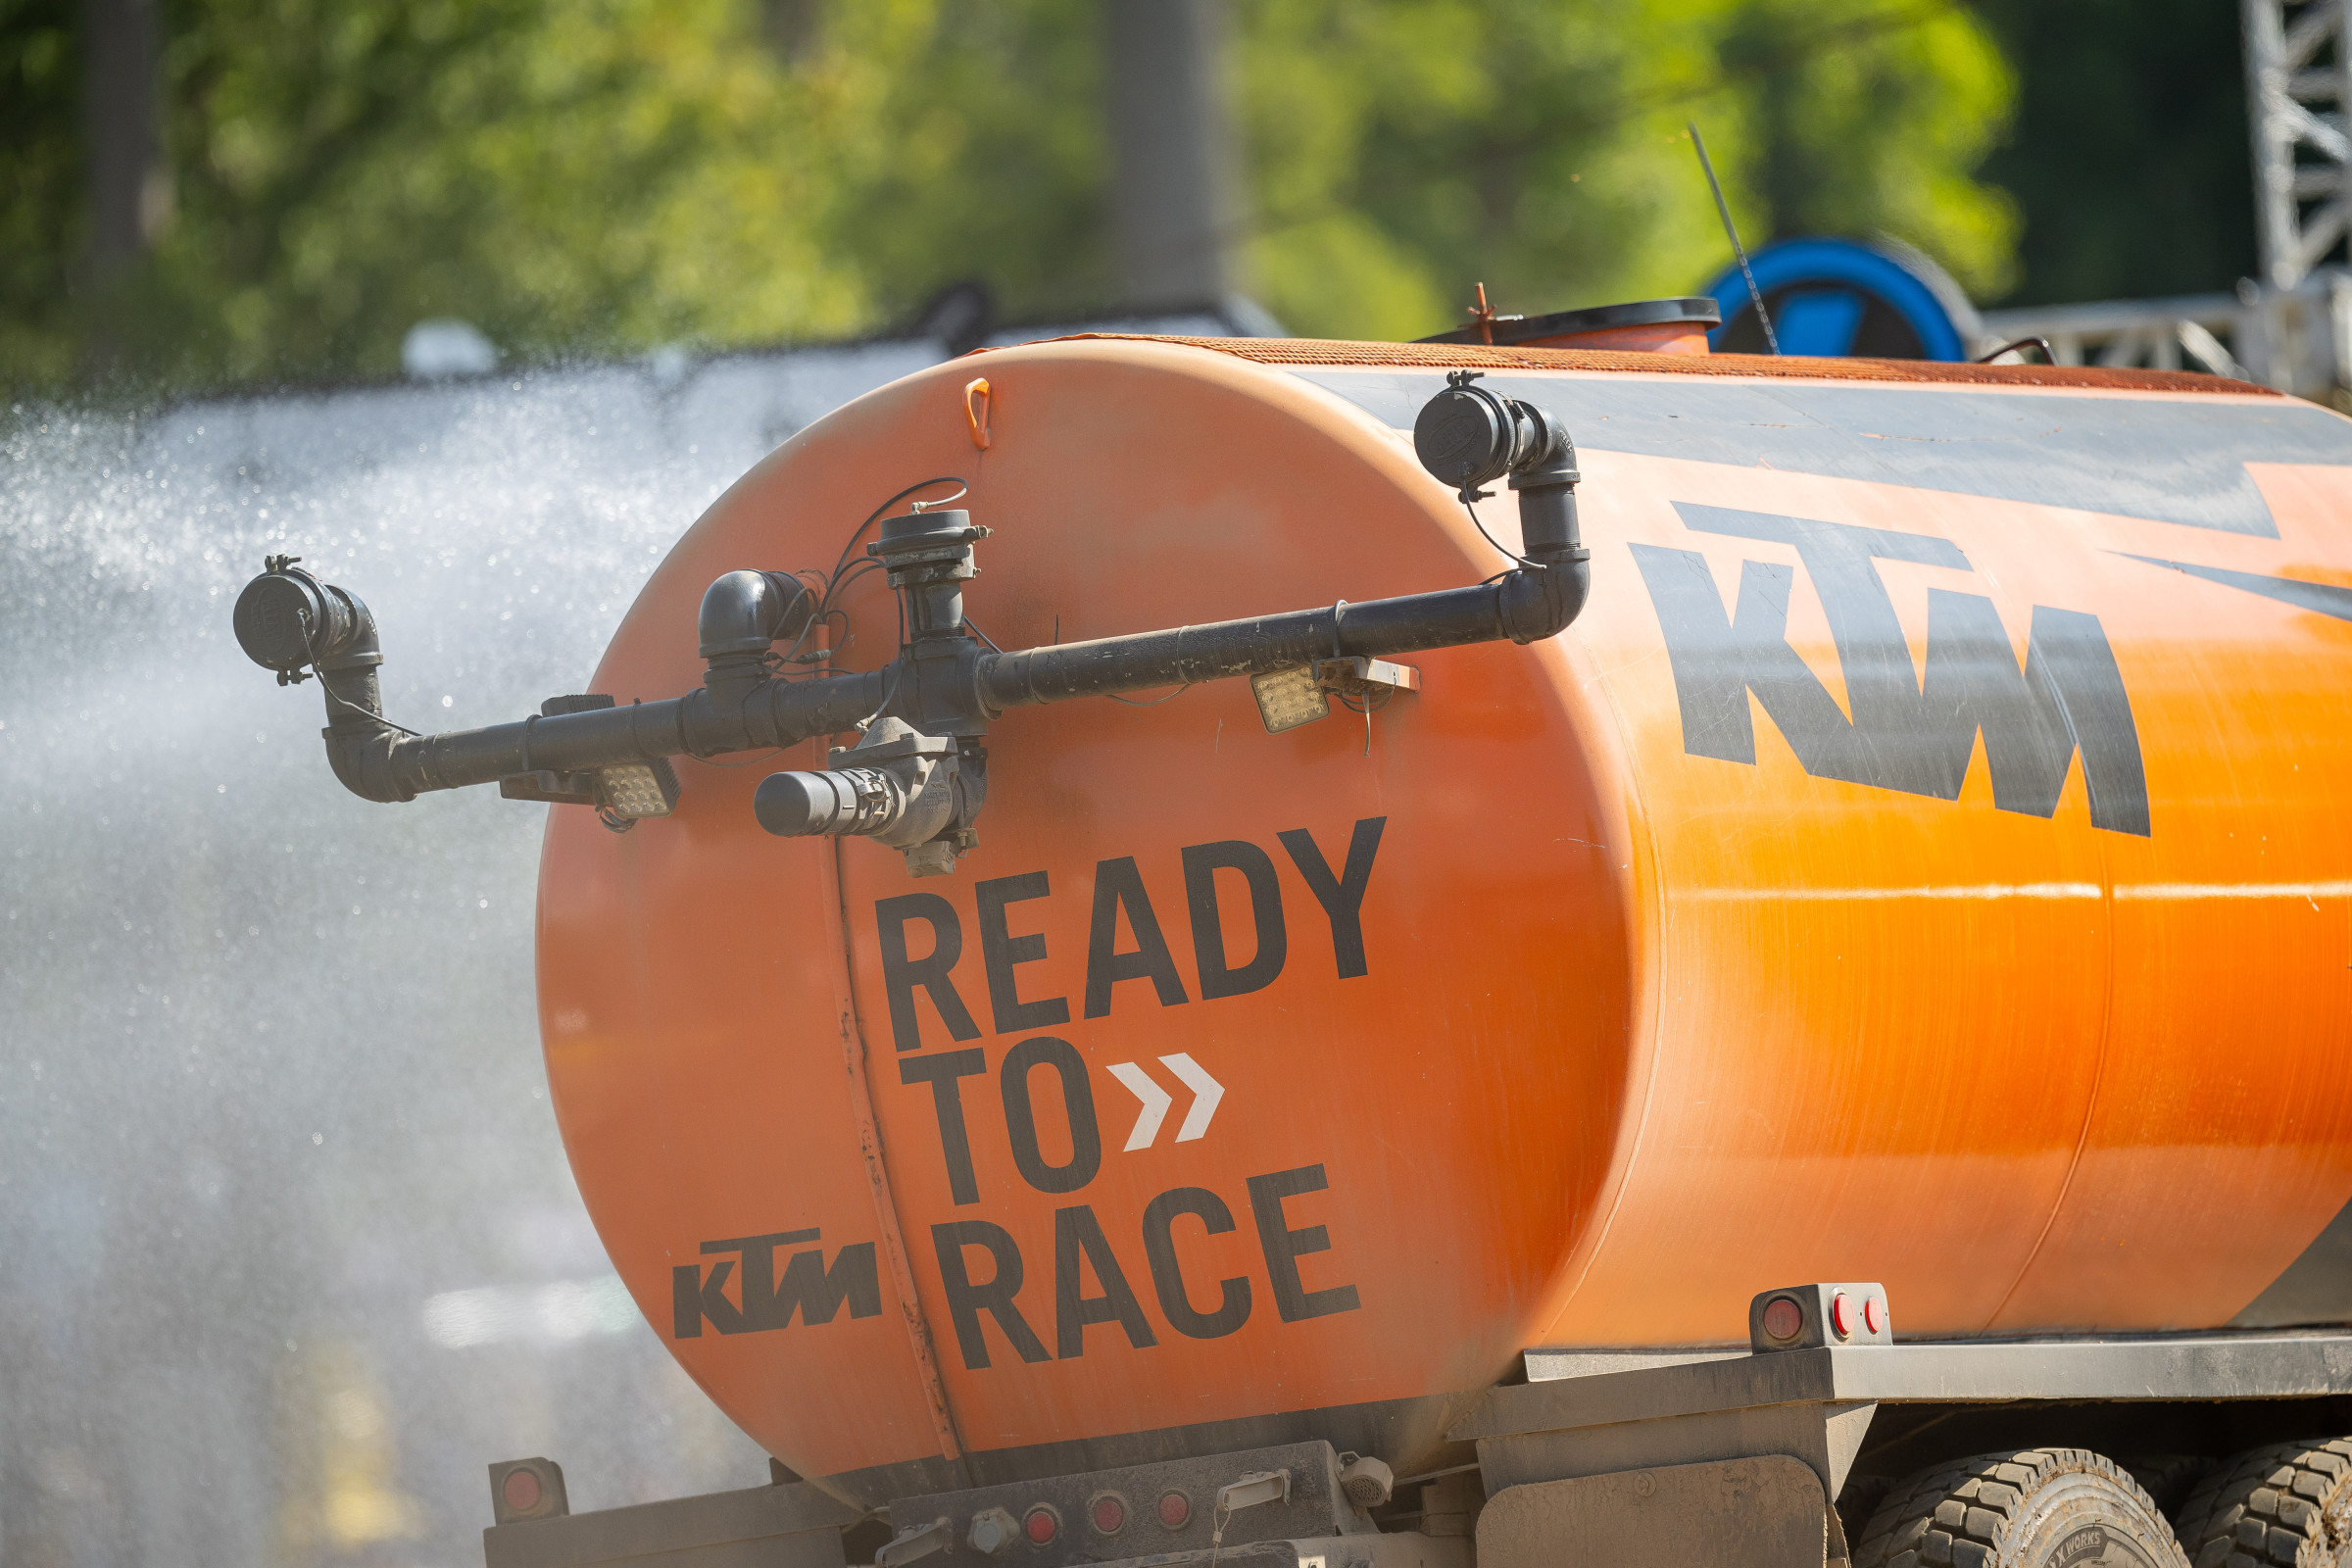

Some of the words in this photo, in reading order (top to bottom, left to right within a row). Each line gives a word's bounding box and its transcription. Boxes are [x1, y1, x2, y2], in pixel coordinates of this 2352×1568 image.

[1627, 500, 2151, 838] KTM
[874, 815, 1388, 1053] READY
[898, 1036, 1102, 1206] TO
[672, 1227, 883, 1339] KTM
[930, 1163, 1361, 1370] RACE
[2065, 1531, 2101, 1555] WORKS
